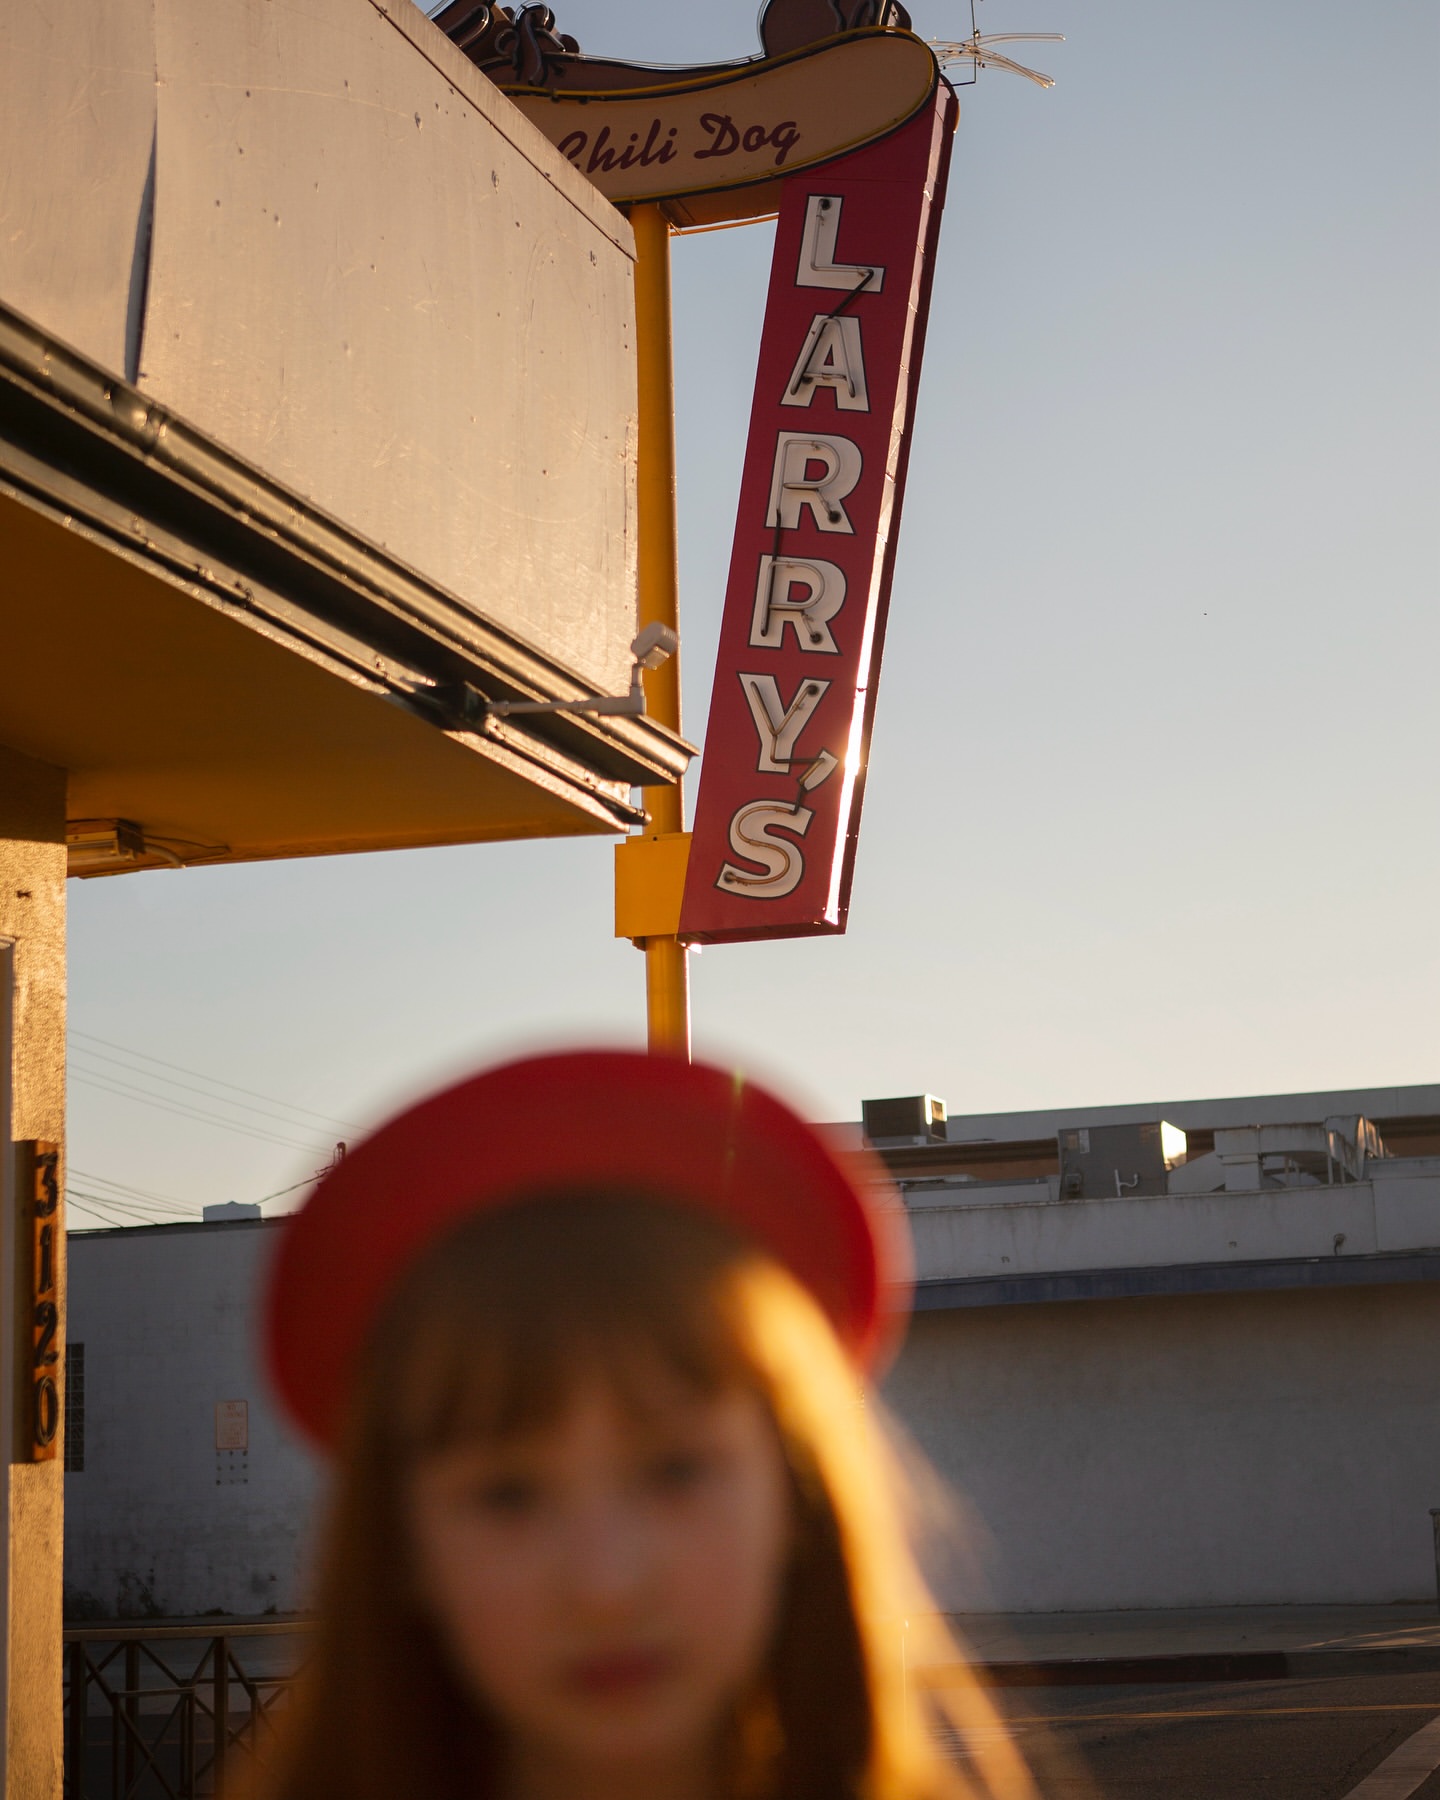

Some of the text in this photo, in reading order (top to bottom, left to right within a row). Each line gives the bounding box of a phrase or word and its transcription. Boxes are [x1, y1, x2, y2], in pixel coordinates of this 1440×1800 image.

[556, 112, 801, 174] Chili Dog
[715, 194, 886, 901] LARRY'S
[35, 1151, 58, 1447] 3120
